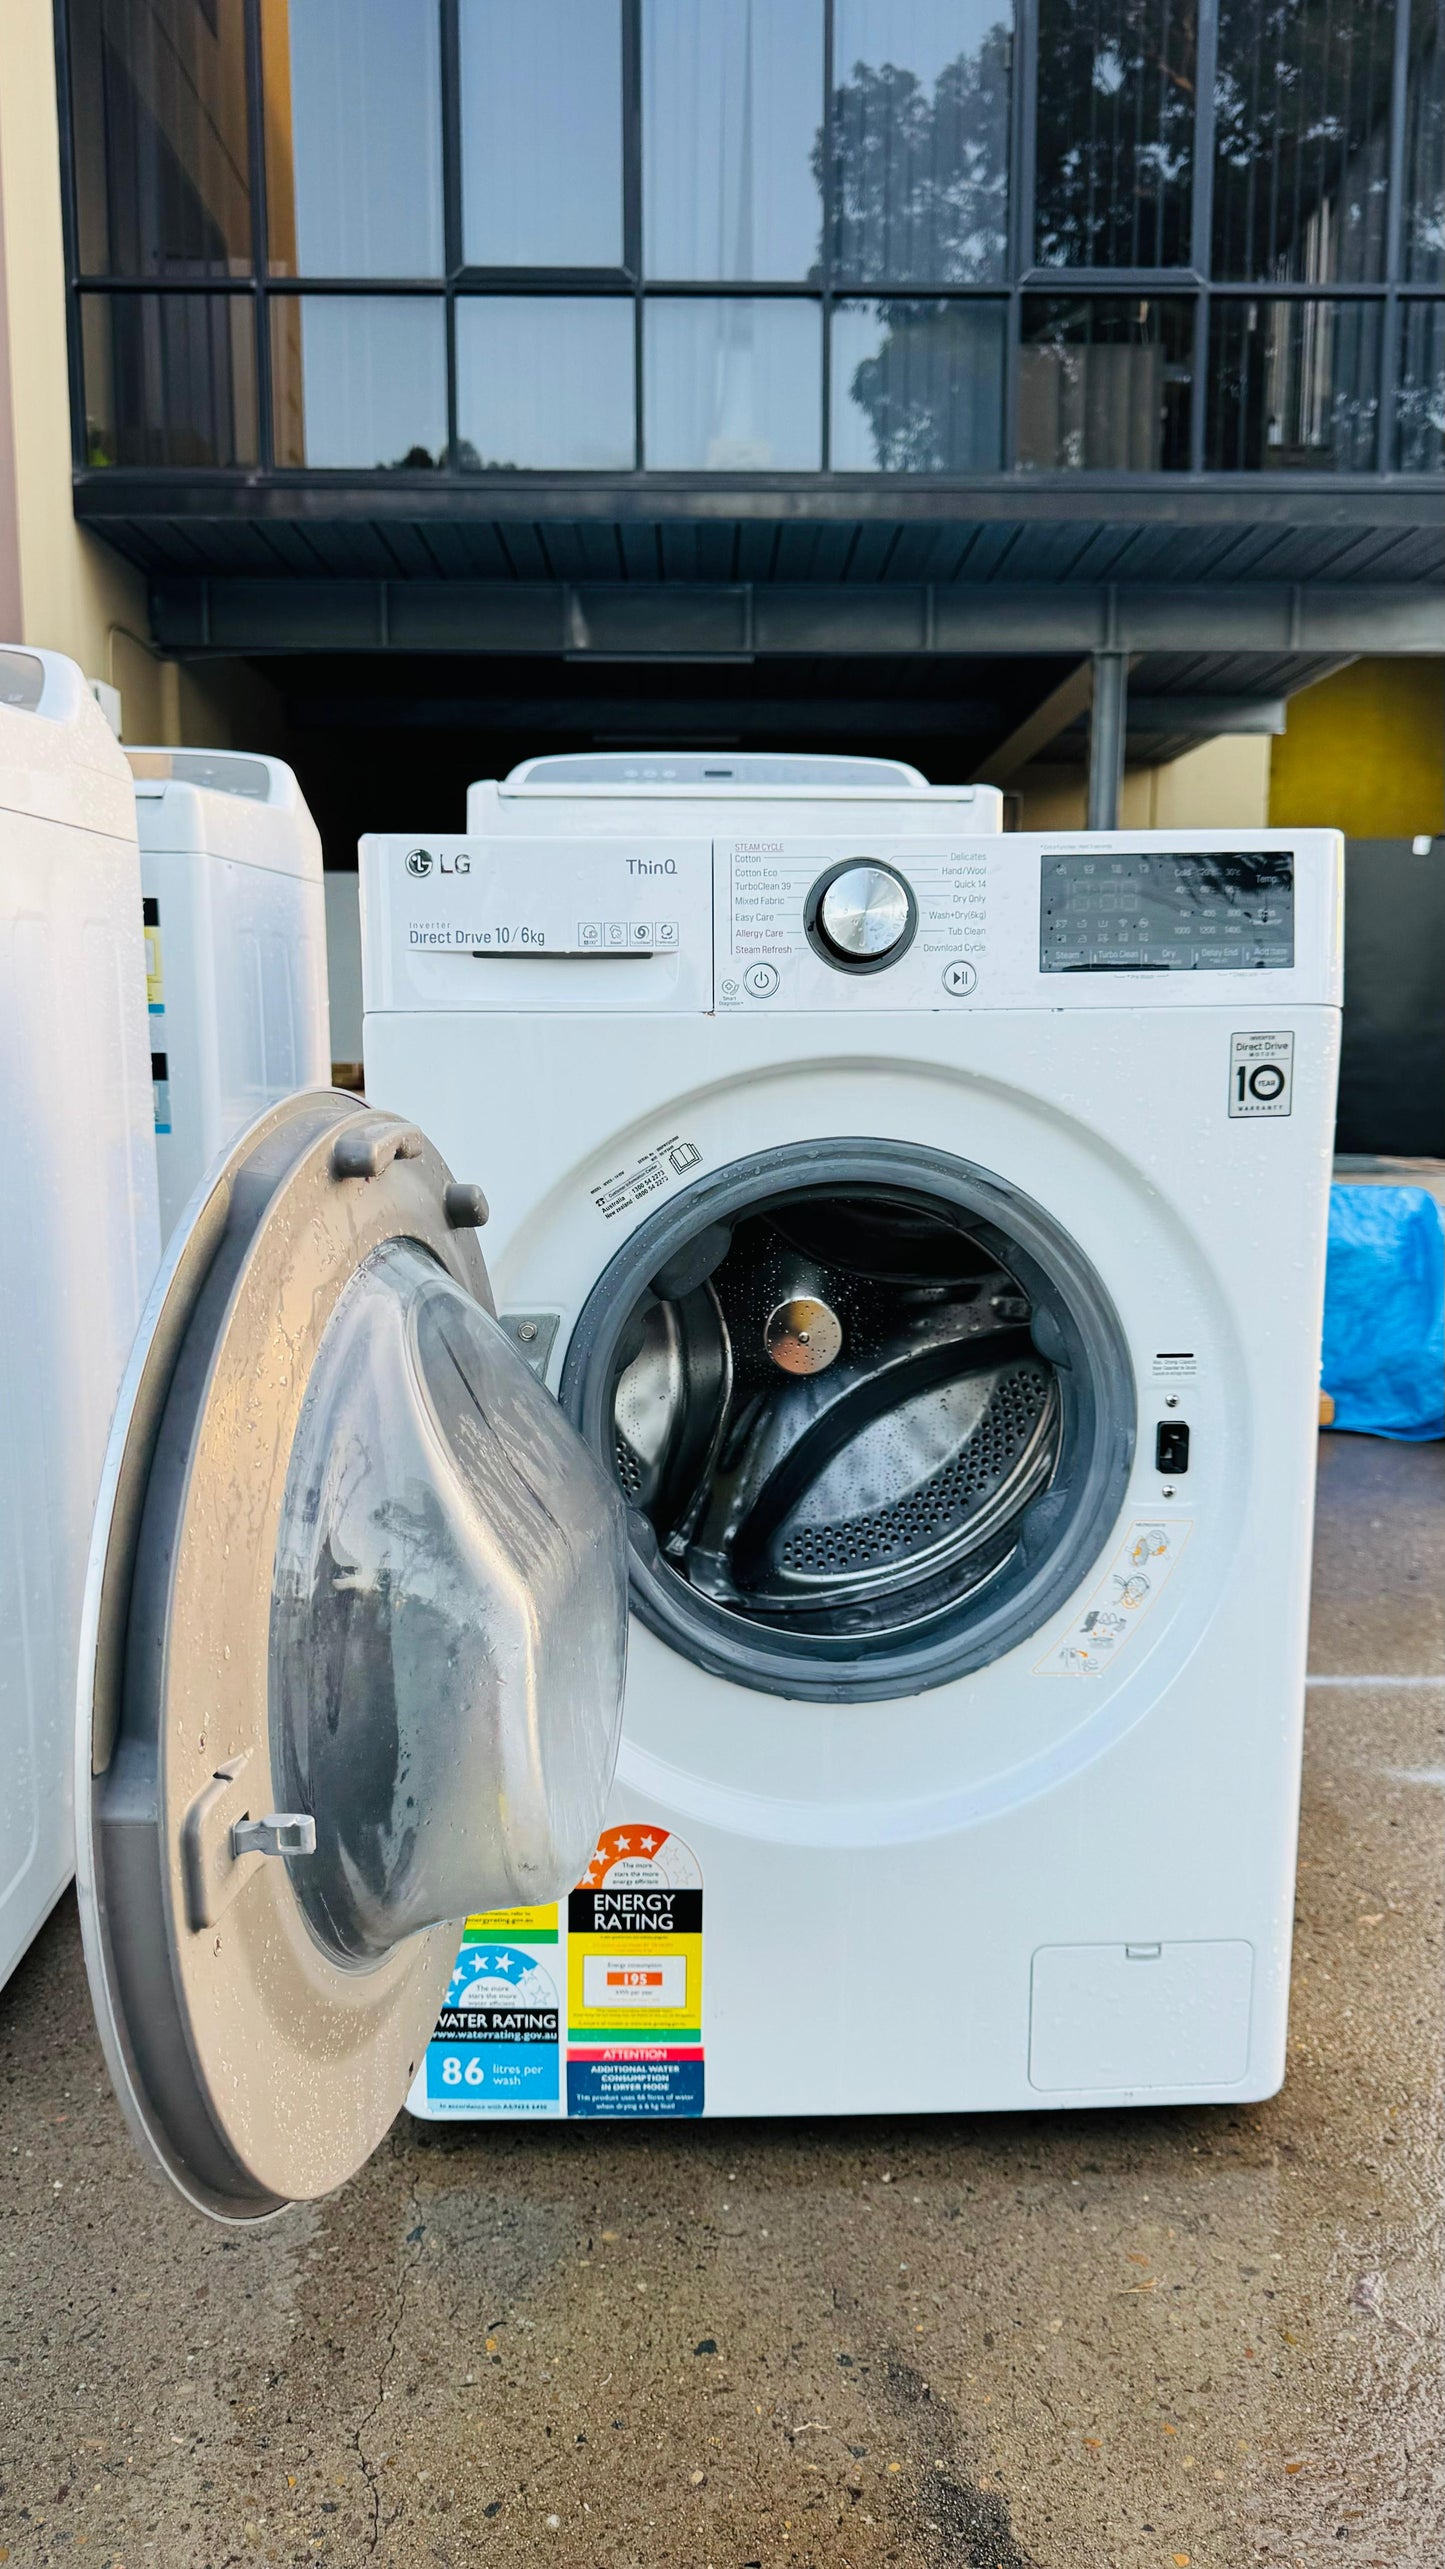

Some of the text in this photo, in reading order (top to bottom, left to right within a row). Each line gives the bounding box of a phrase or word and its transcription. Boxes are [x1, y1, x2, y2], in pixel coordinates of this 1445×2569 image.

[761, 843, 784, 851] CYCLE
[735, 854, 761, 863] Cotton
[950, 852, 987, 861] Delicates
[440, 853, 472, 874] LG
[625, 859, 678, 875] ThinQ
[735, 868, 778, 877] Cotton Eco
[942, 866, 987, 875] Hand/Wool
[735, 882, 792, 891] TurboClean 39
[954, 880, 986, 888] Quick 14
[735, 897, 785, 905] Mixed Fabric
[952, 894, 986, 904] Dry Only
[735, 913, 775, 923] Easy Care
[736, 929, 784, 939] Allergy Care
[948, 927, 986, 936] Tub Clean
[410, 930, 452, 944] Direct
[455, 930, 491, 944] Drive
[735, 945, 792, 954] Steam Refresh
[923, 943, 986, 953] Download Cycle
[1055, 951, 1081, 960] Steam
[1098, 950, 1118, 959] Turbo
[1162, 949, 1176, 960] Dry
[1236, 1042, 1289, 1051] Direct Drive
[1236, 1064, 1285, 1101] 10
[601, 1196, 626, 1214] Australia
[631, 1182, 645, 1194] 1300
[644, 1177, 652, 1186] 54
[605, 1210, 616, 1219] New
[593, 1894, 676, 1911] ENERGY
[594, 1913, 674, 1930] RATING
[623, 1973, 648, 1986] 195
[492, 2014, 557, 2029] RATING
[603, 2049, 667, 2060] ATTENTION
[442, 2057, 485, 2086] 86
[492, 2064, 544, 2077] litres per
[590, 2065, 680, 2074] ADDITIONAL WATER
[492, 2075, 521, 2086] wash
[601, 2074, 670, 2083] CONSUMPTION
[600, 2083, 670, 2091] IN DRYER MODE
[591, 2093, 619, 2102] product
